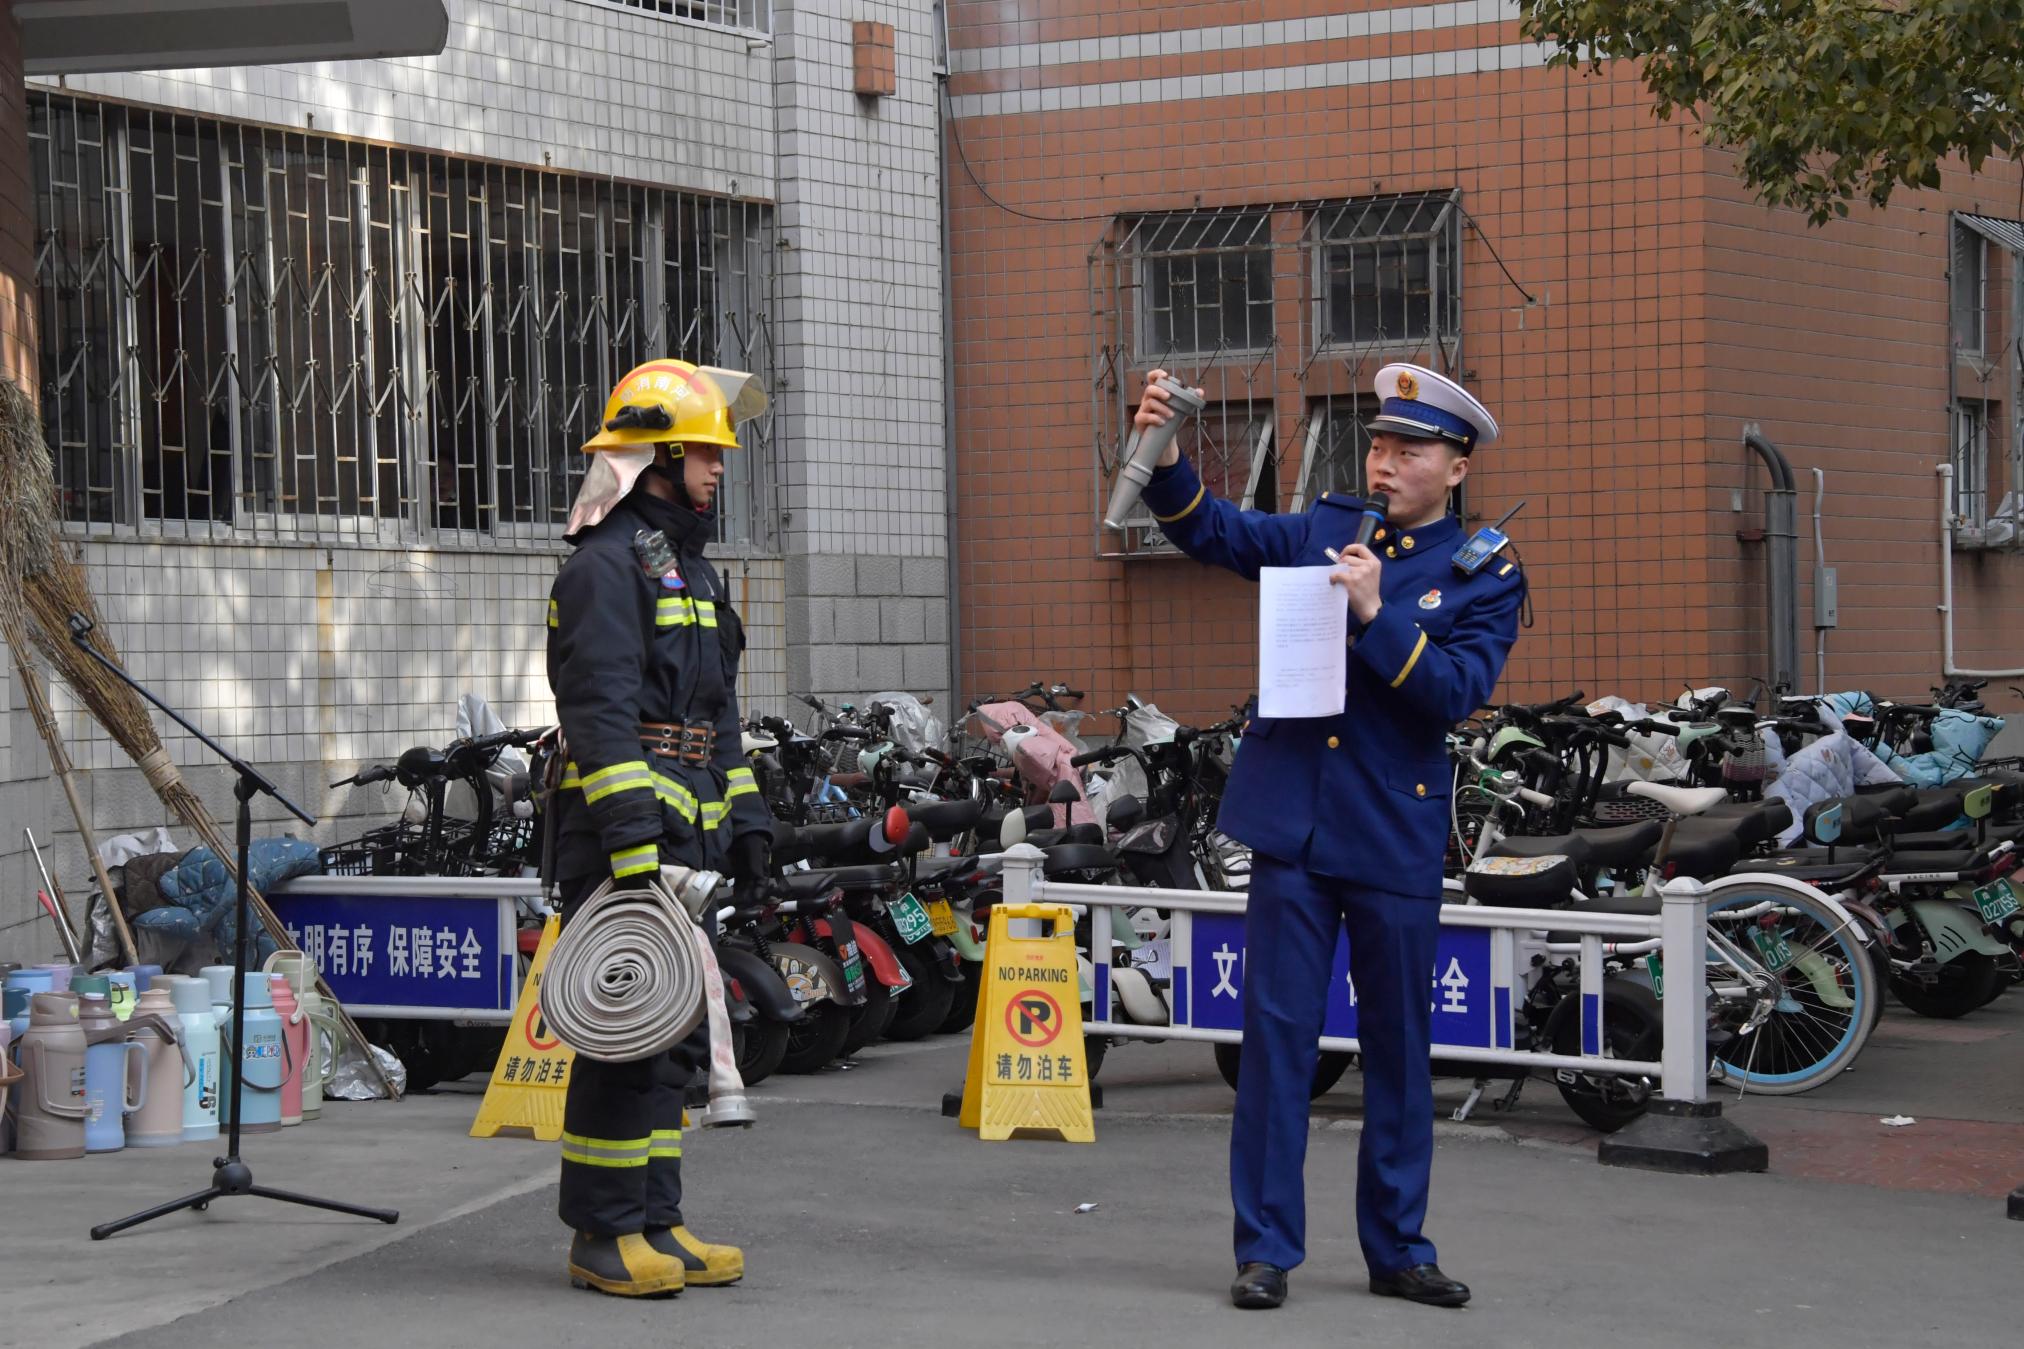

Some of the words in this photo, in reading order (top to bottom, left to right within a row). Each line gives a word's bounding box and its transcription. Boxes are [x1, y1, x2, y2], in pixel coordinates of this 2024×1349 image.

[387, 924, 483, 979] 保障安全
[998, 966, 1016, 981] NO
[1018, 967, 1068, 983] PARKING
[504, 1055, 567, 1084] 请勿泊车
[996, 1053, 1073, 1082] 请勿泊车
